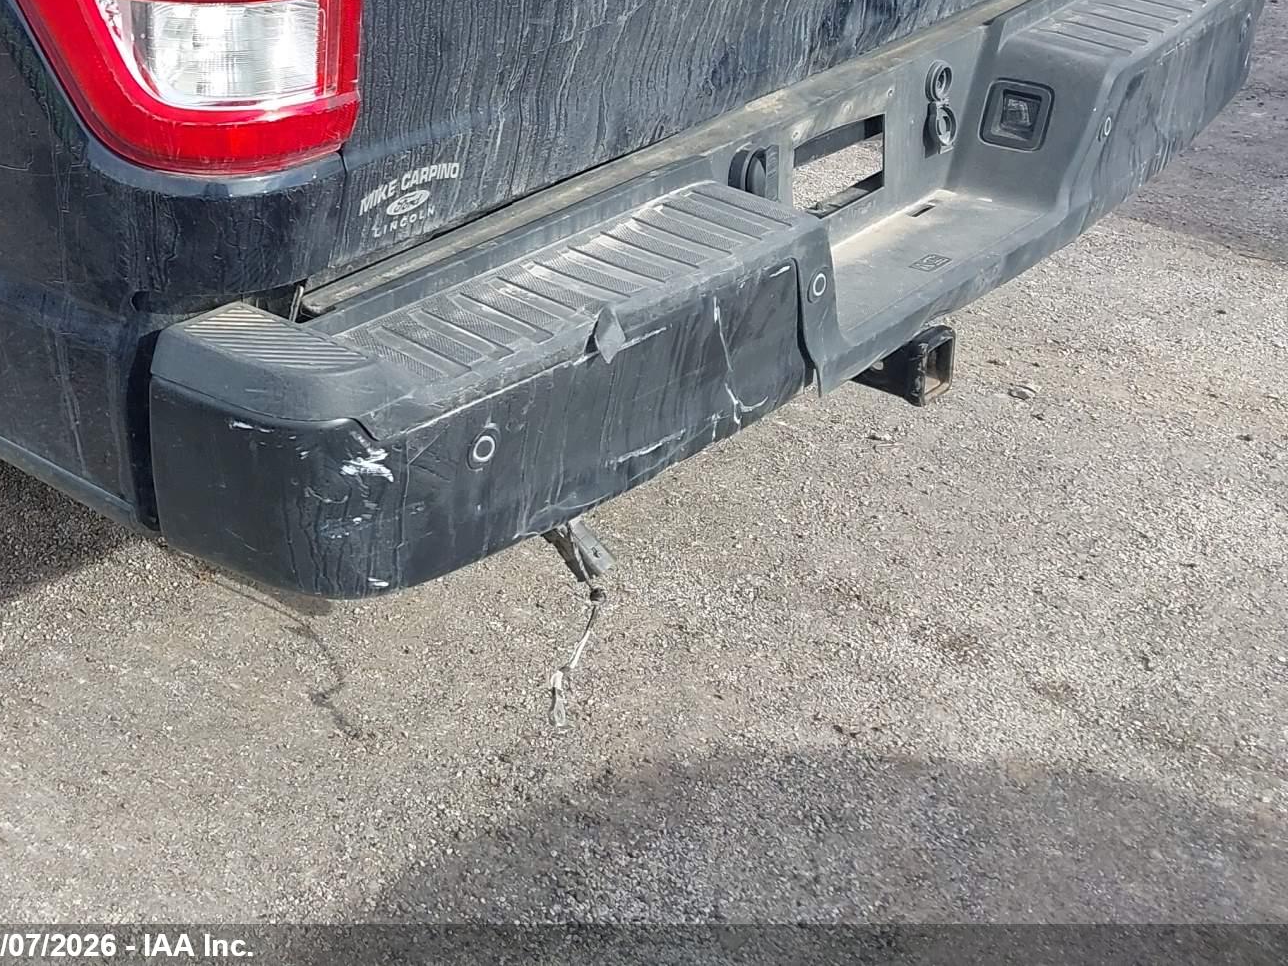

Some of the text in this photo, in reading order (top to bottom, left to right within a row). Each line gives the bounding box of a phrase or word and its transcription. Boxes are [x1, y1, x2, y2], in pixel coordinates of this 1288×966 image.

[359, 163, 460, 216] MIKE CARPINO
[372, 205, 436, 239] LINCOLN
